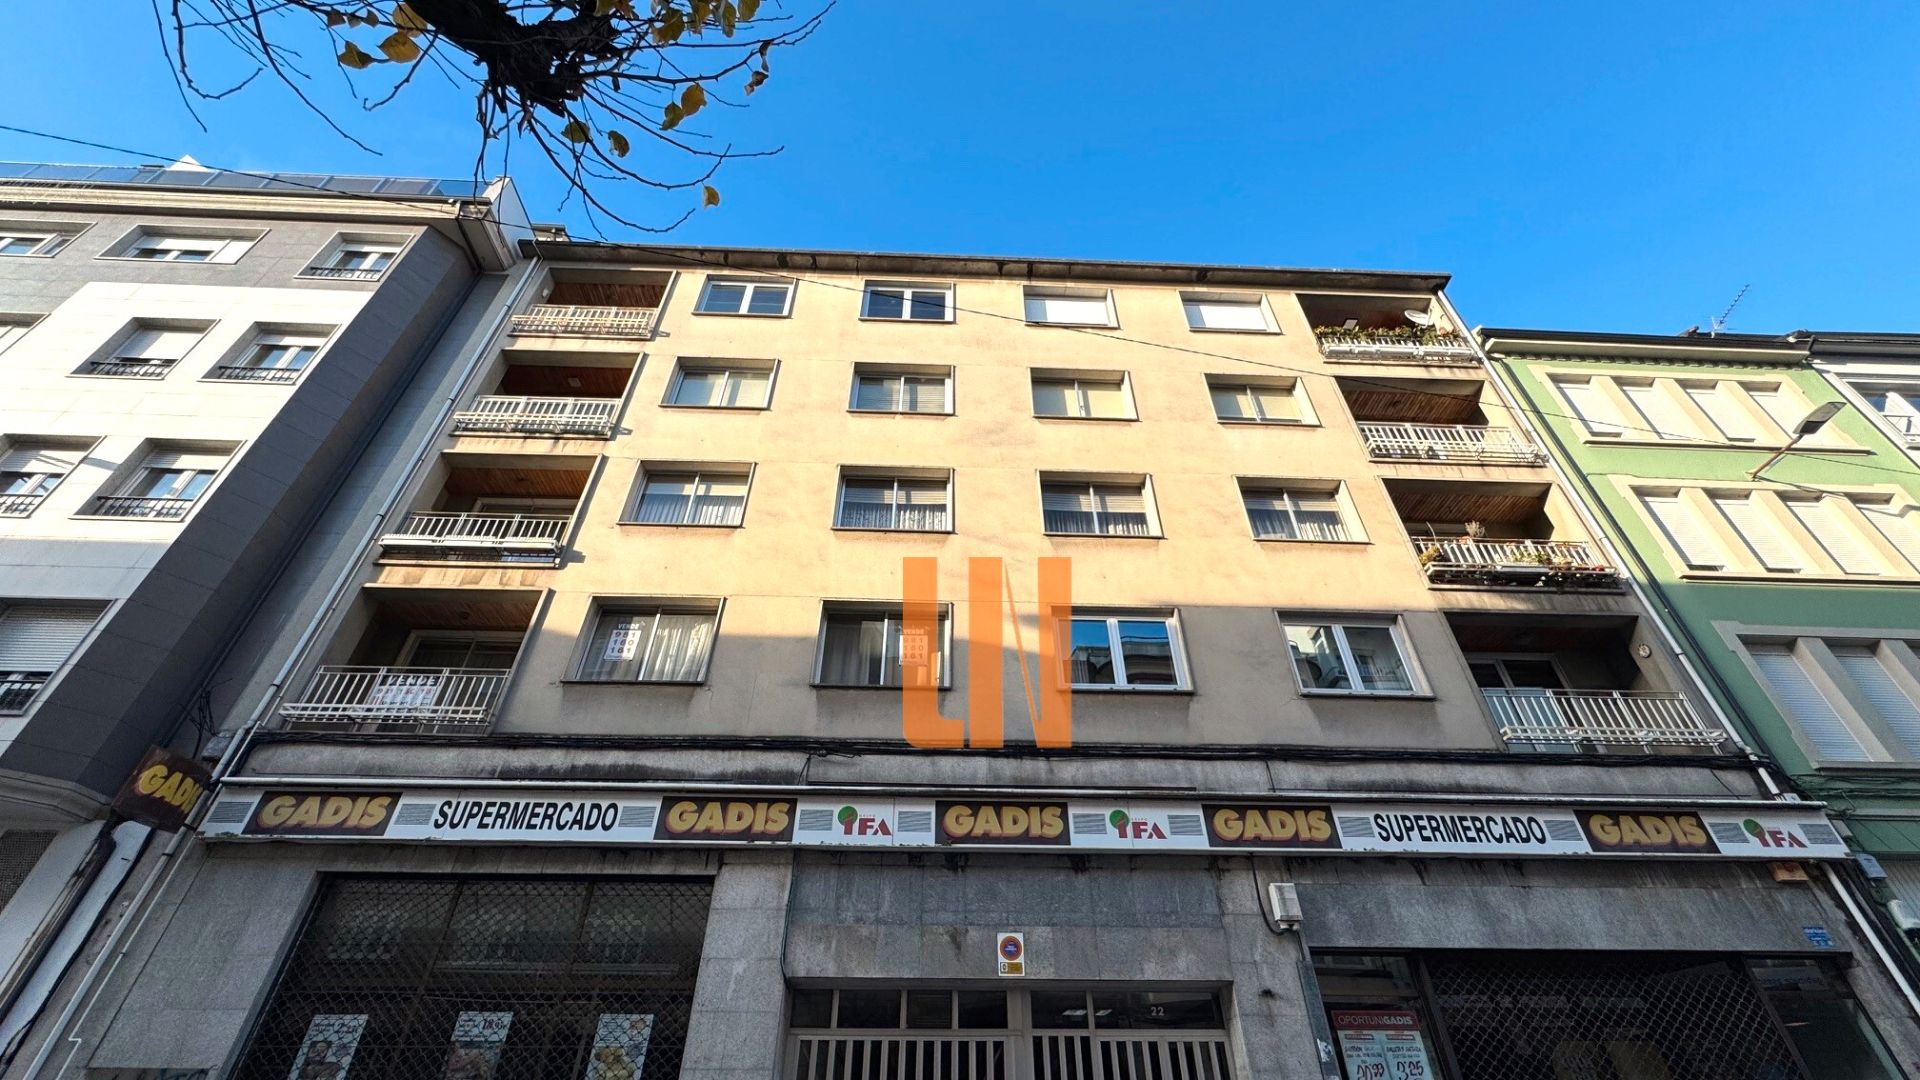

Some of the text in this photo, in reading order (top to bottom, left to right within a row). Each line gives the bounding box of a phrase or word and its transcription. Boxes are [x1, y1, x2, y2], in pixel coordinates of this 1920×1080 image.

[387, 675, 436, 686] VENDE
[257, 795, 393, 829] GADIS
[433, 800, 619, 832] SUPERMERCADO
[667, 801, 791, 834] GADIS
[943, 805, 1064, 839] GADIS
[1213, 808, 1332, 842] GADIS
[1373, 813, 1547, 845] SUPERMERCADO
[1589, 814, 1707, 847] GADIS
[1151, 1006, 1165, 1016] 22
[1338, 1015, 1414, 1025] OPORTUNIGADIS
